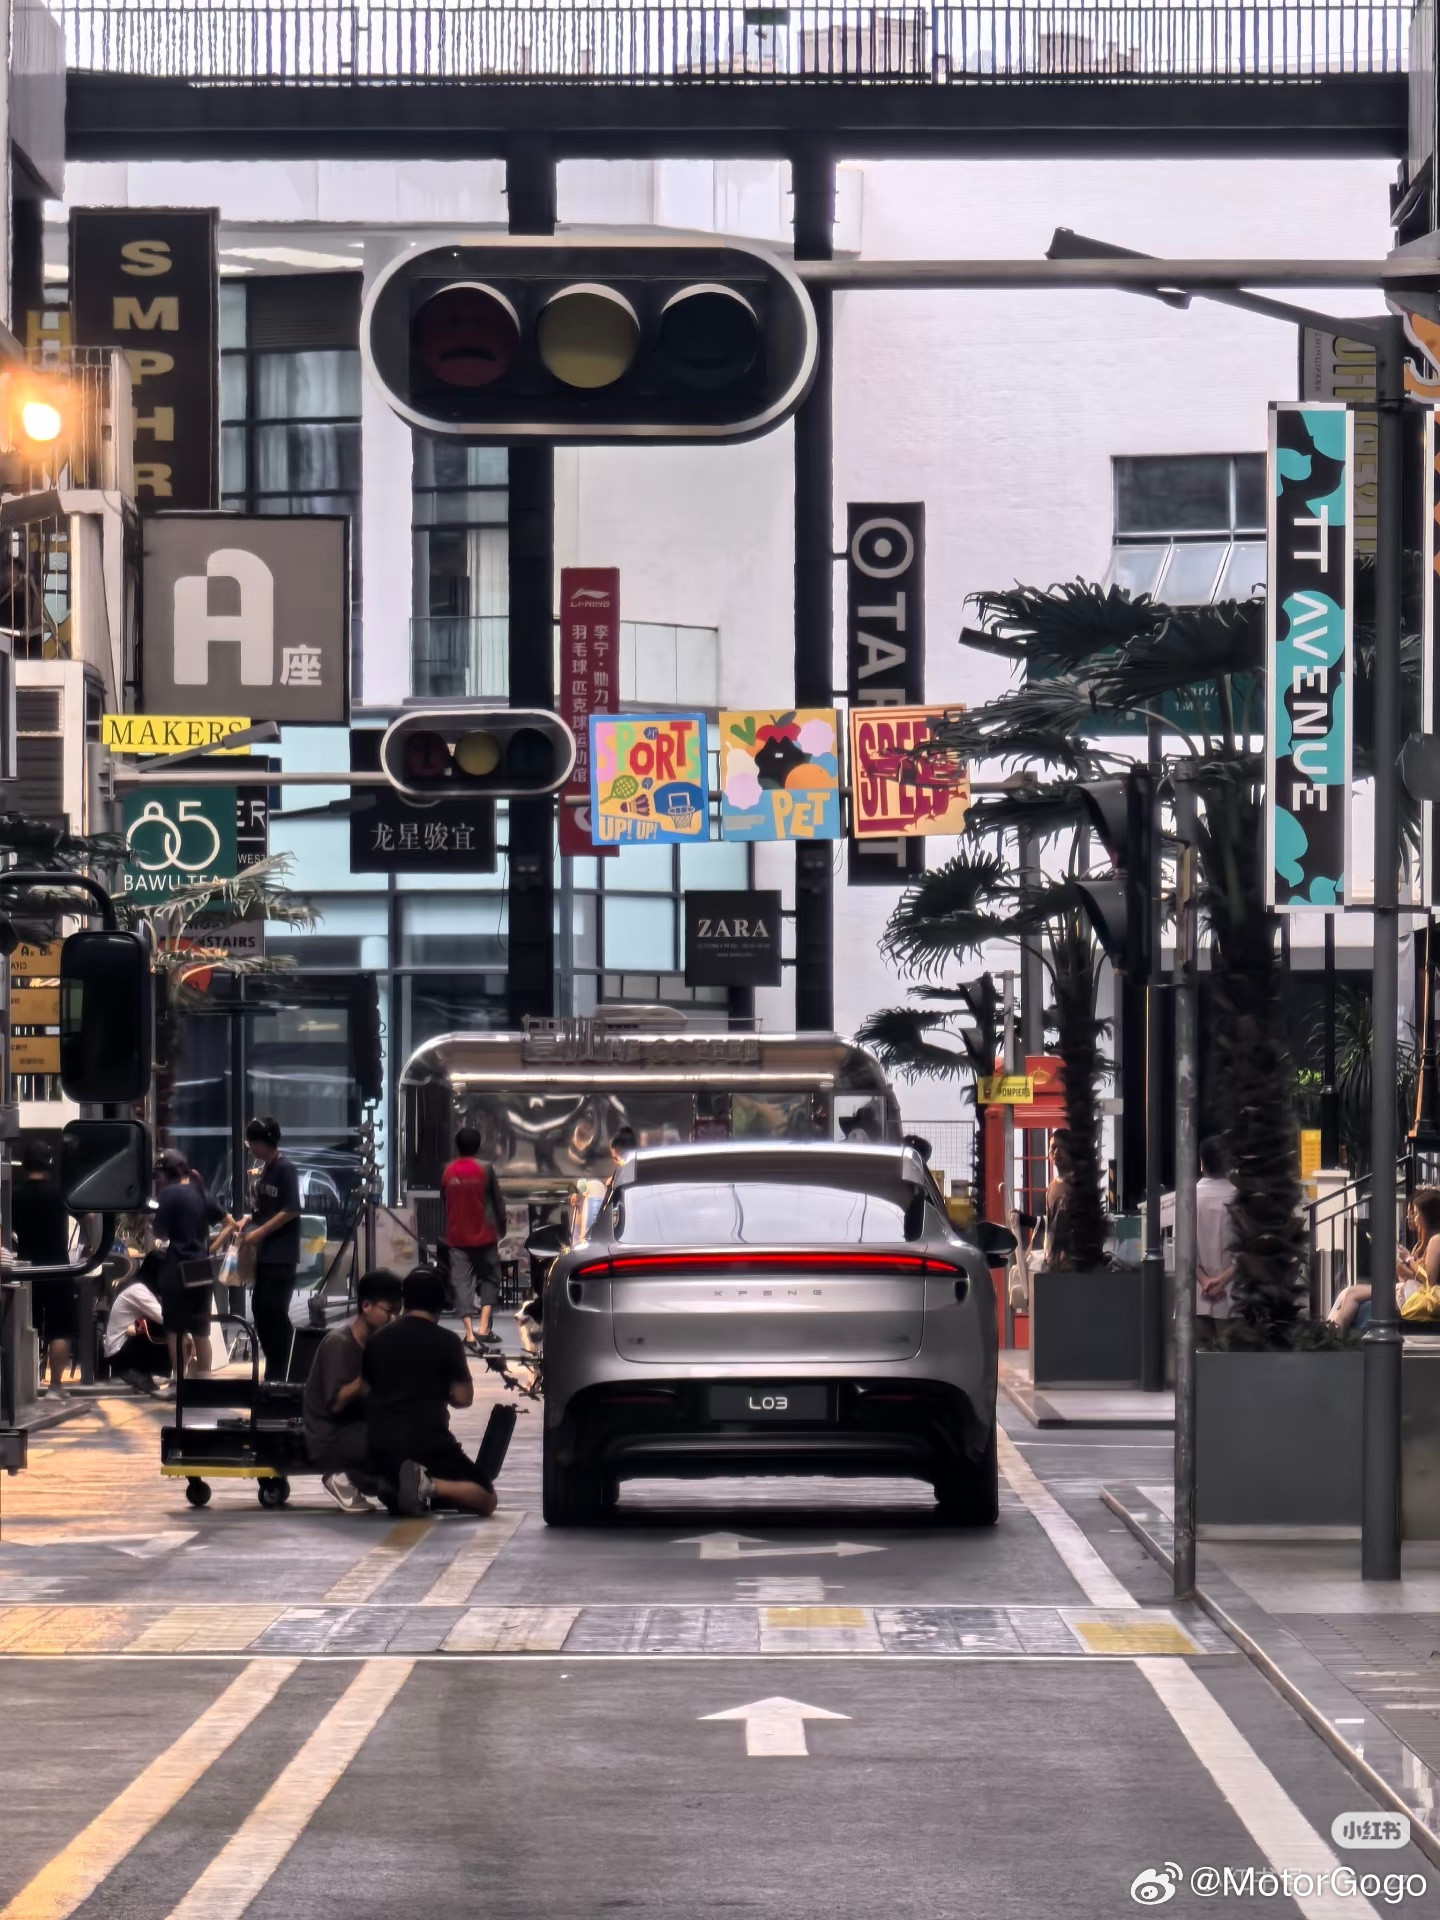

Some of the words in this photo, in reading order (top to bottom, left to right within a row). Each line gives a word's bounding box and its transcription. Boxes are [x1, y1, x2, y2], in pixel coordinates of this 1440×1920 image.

[1292, 504, 1328, 573] TT
[572, 624, 587, 675] 羽毛球
[1292, 592, 1328, 812] AVENUE
[596, 721, 701, 781] SPORTS
[599, 814, 633, 841] UP!
[771, 790, 831, 839] PET
[370, 822, 477, 852] 龙星骏宜
[124, 874, 180, 892] BAWU
[697, 919, 770, 938] ZARA
[713, 1289, 824, 1297] XPENG
